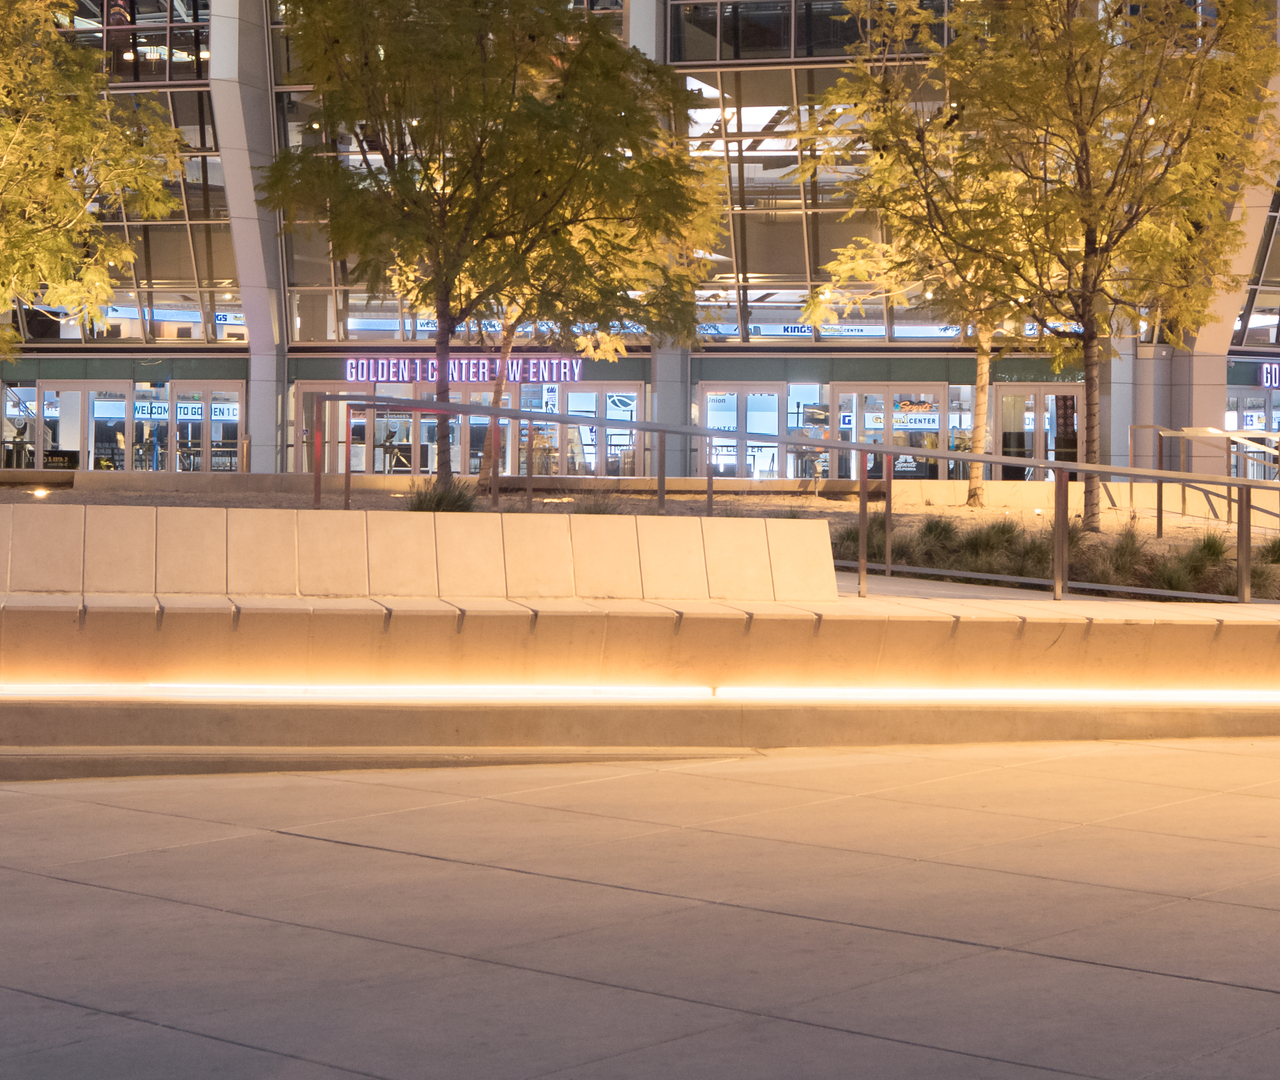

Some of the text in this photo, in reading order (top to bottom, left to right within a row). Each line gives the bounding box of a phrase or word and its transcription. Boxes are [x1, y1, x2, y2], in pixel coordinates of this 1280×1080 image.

[783, 325, 813, 334] KINGS
[345, 358, 582, 382] GOLDEN 1 CNTER W ENTRY
[134, 405, 169, 416] WELCOM
[178, 406, 189, 416] TO
[908, 417, 936, 425] CENTER
